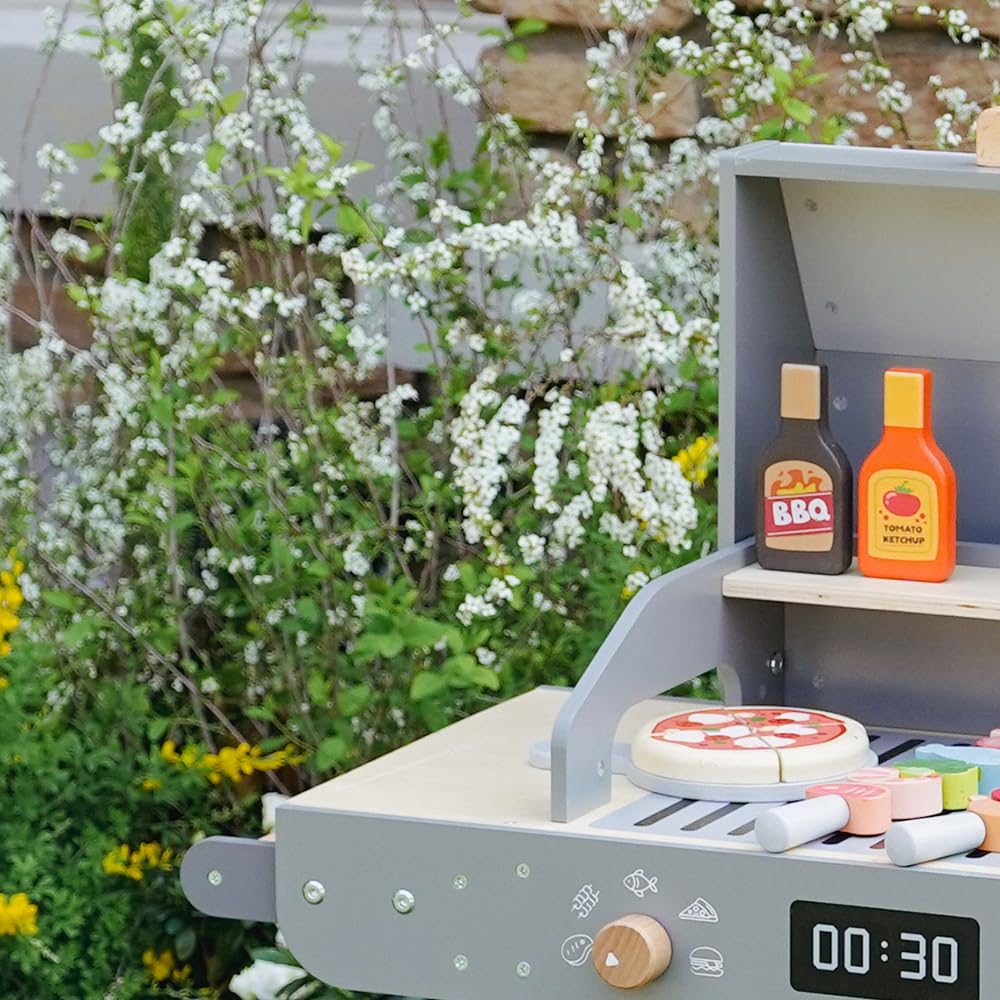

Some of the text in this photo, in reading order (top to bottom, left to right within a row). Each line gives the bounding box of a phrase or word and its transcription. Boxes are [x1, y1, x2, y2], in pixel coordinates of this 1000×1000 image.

[772, 498, 831, 526] BBQ
[884, 524, 923, 534] TOMATO
[882, 534, 926, 545] KETCHUP
[812, 923, 959, 984] 00:30
